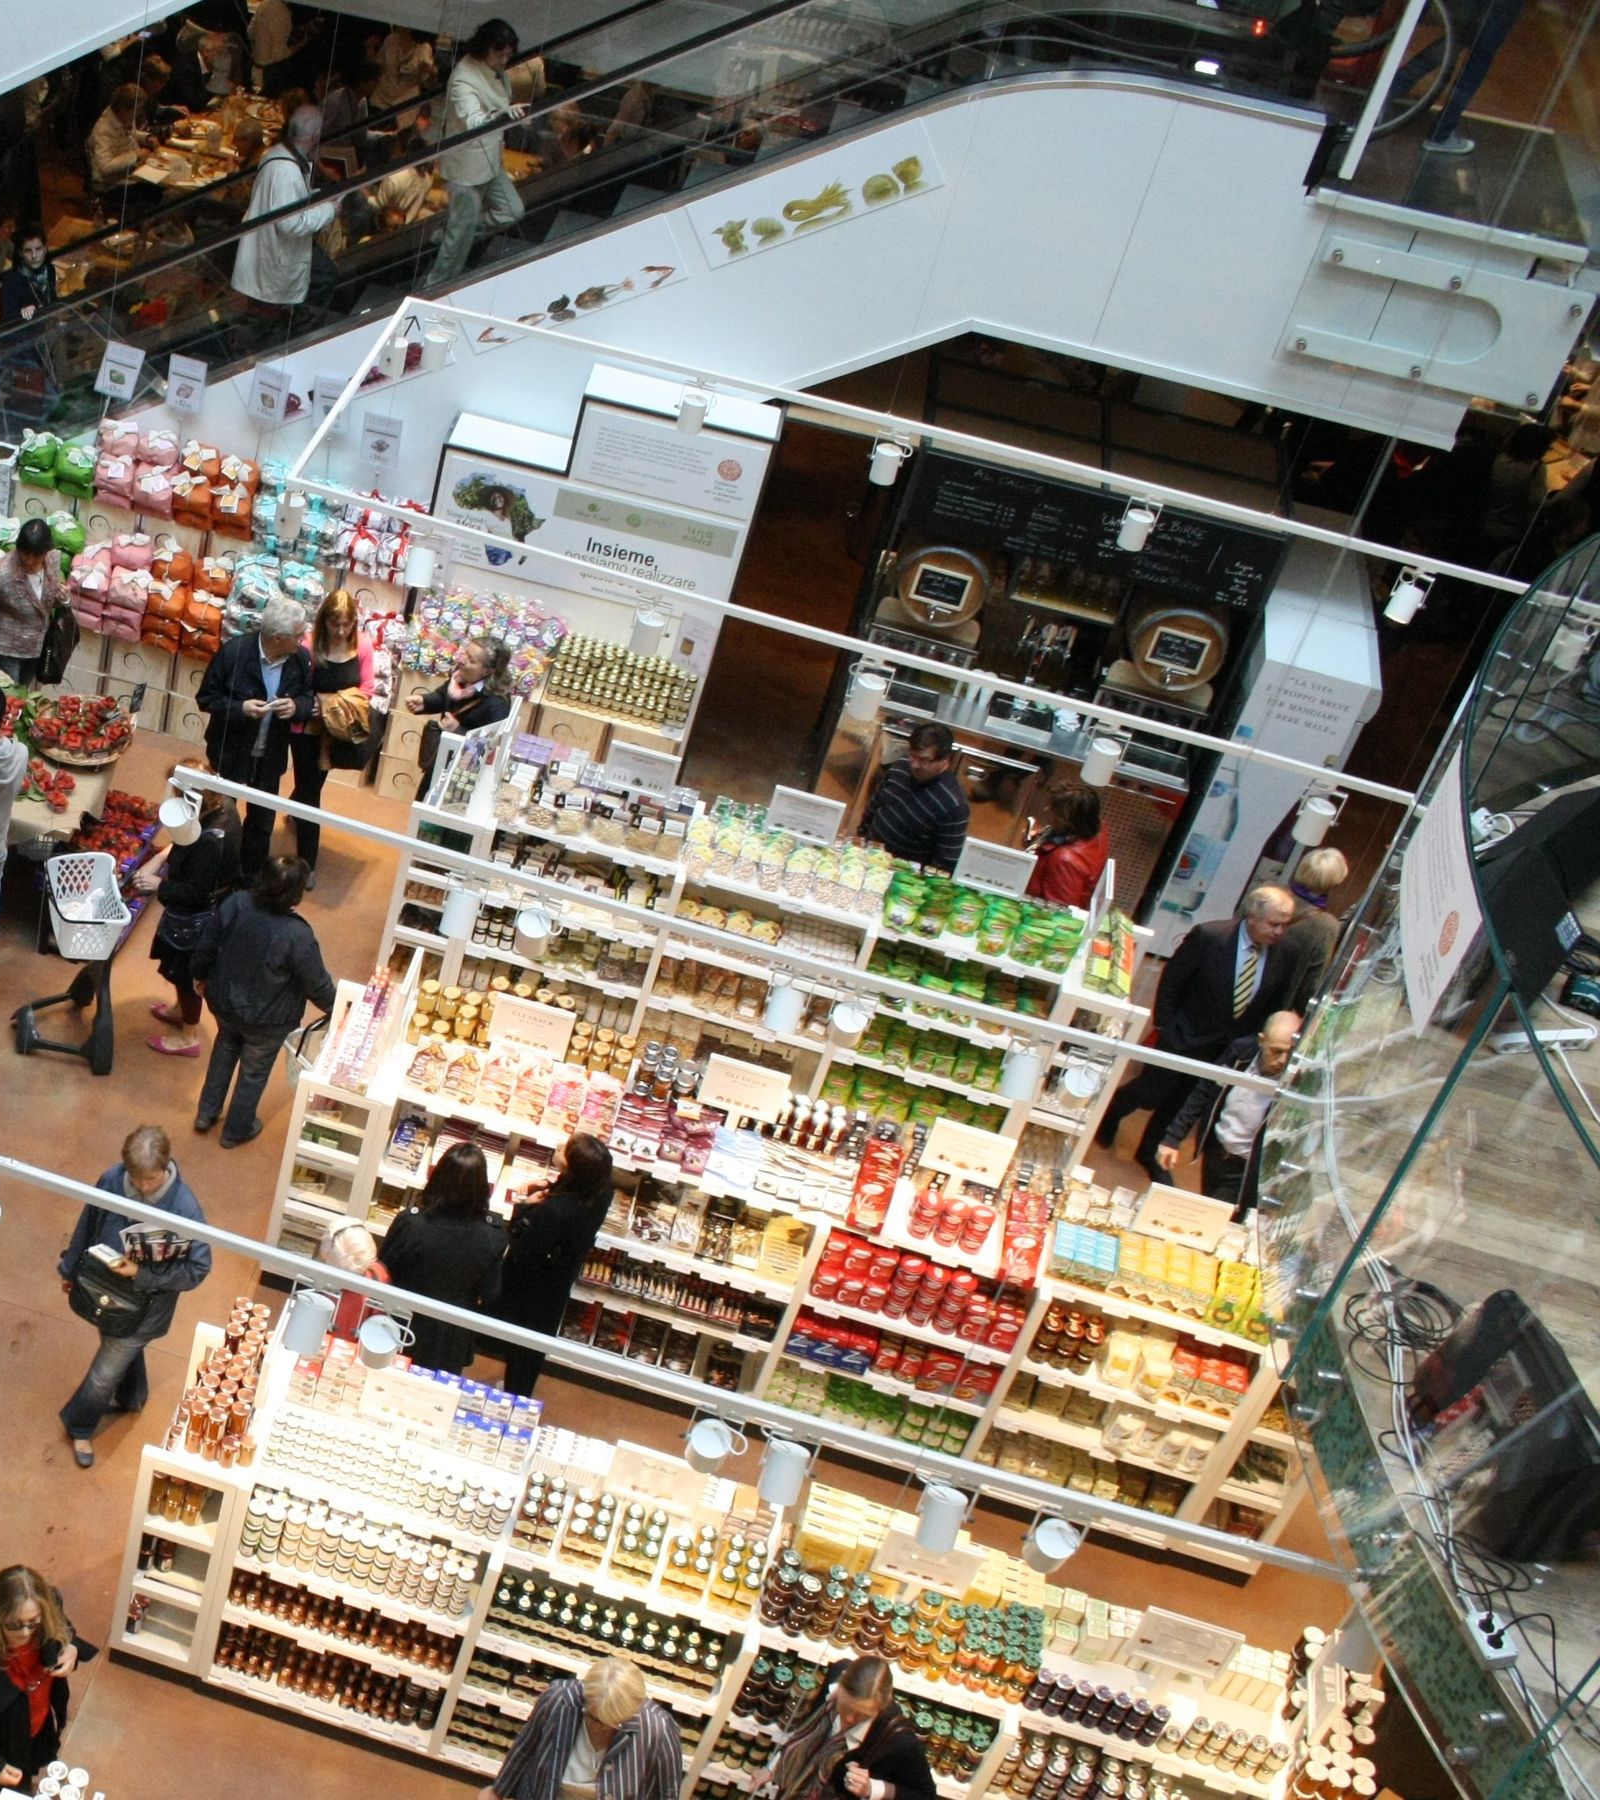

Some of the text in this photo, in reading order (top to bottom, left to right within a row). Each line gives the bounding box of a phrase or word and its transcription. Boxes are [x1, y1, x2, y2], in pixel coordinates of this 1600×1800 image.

[585, 536, 659, 571] Insieme,
[631, 565, 697, 591] realizzare
[1278, 687, 1316, 703] TROPPO
[1320, 699, 1350, 712] BREVE
[1311, 683, 1333, 694] VITA
[1289, 703, 1341, 721] MANGIARE
